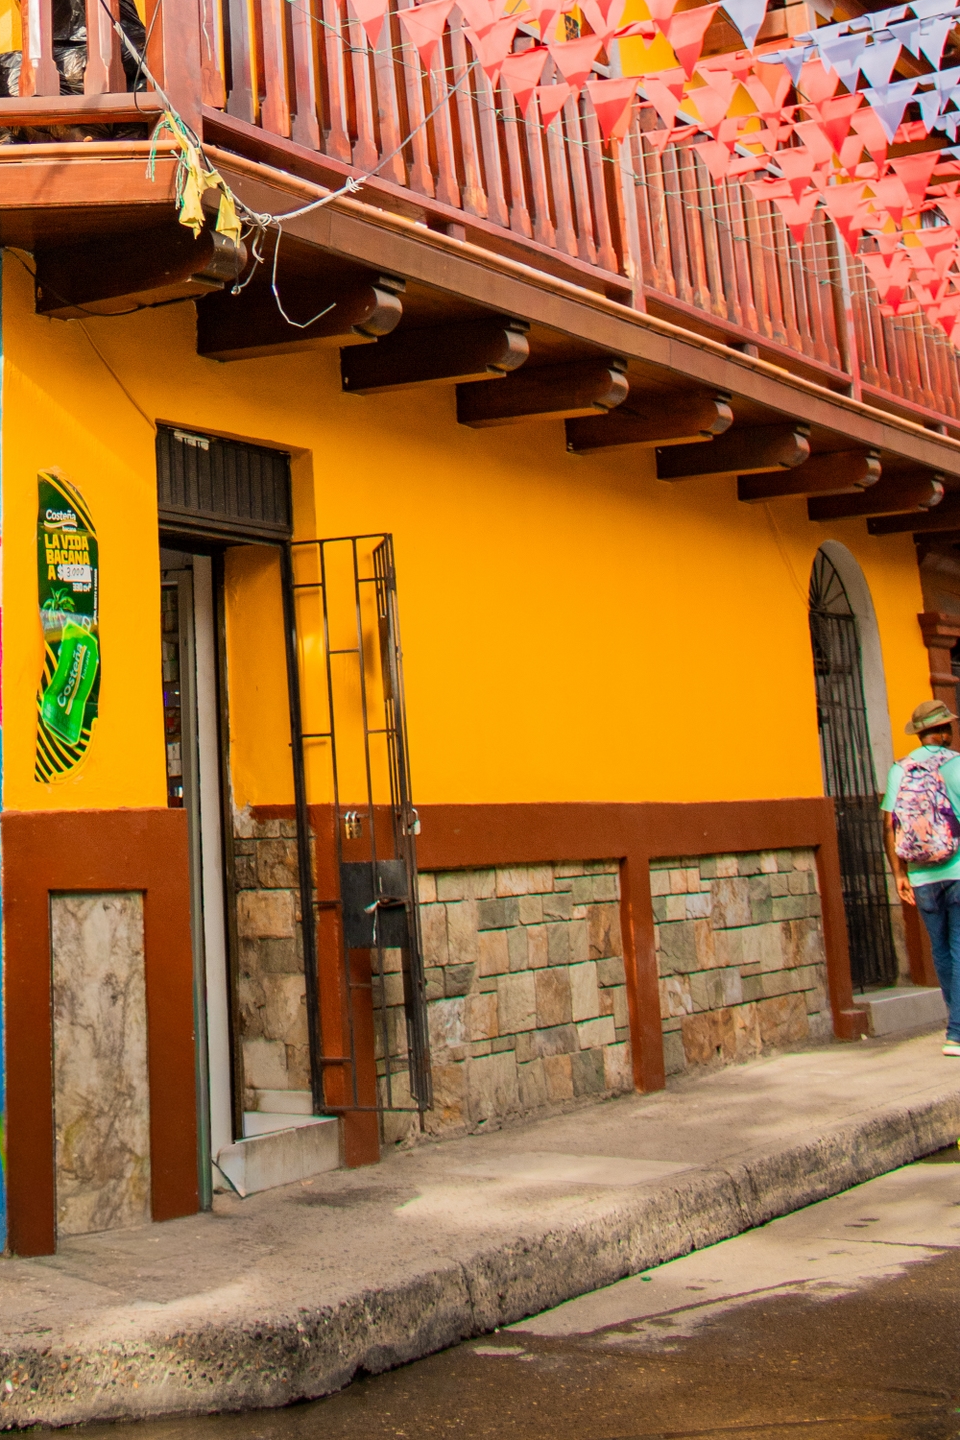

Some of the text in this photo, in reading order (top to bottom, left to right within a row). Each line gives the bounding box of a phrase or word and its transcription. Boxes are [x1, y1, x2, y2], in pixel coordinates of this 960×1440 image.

[45, 509, 76, 521] Costeña
[44, 533, 89, 550] LA VIDA
[46, 549, 90, 565] BACANA
[48, 565, 56, 580] A
[57, 643, 83, 707] Costeña
